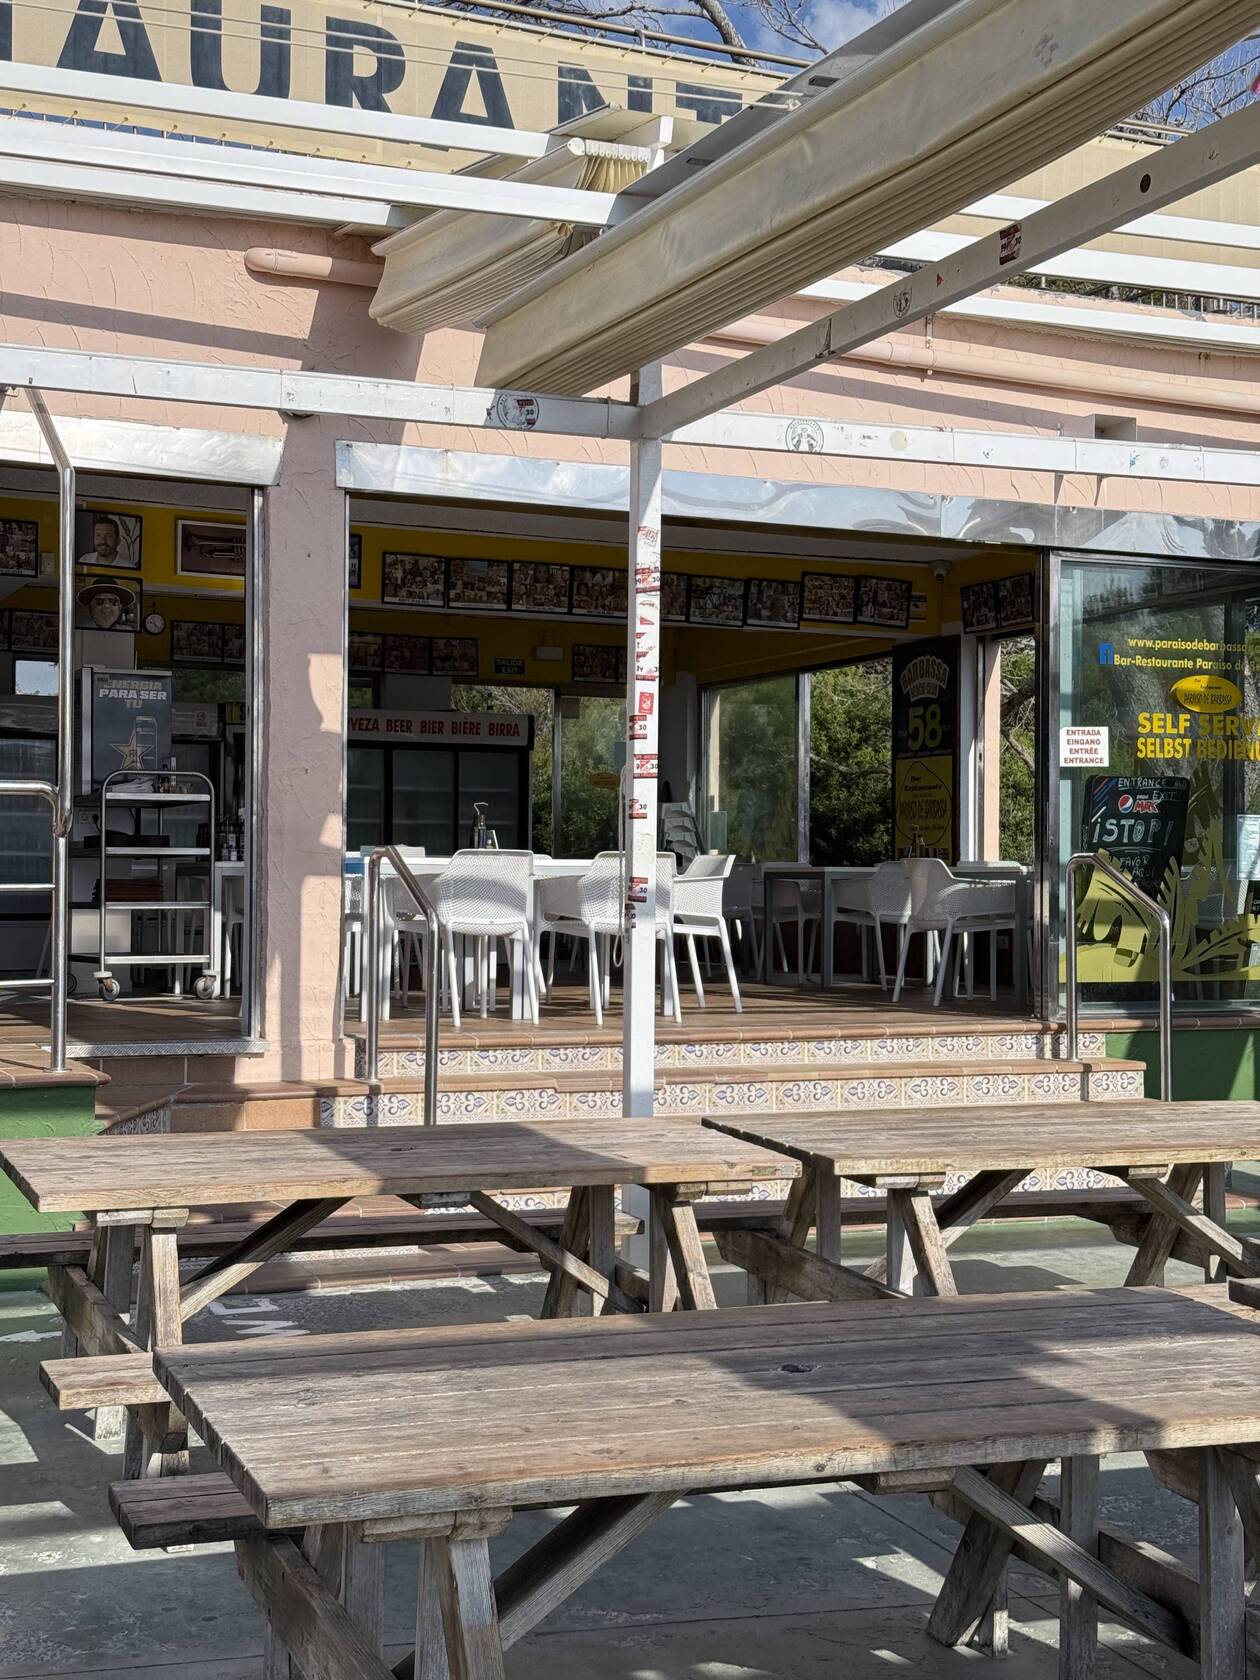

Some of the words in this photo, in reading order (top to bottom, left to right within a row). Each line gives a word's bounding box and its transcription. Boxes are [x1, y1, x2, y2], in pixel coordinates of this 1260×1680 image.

[1114, 655, 1194, 669] Bar-Restaurante
[1196, 657, 1232, 670] Paraiso
[99, 688, 137, 699] PARA
[139, 690, 168, 700] SER
[348, 717, 380, 733] VEZA
[386, 718, 413, 734] BEER
[420, 719, 445, 736] BIER
[451, 717, 481, 736] BIÈRE
[488, 722, 521, 737] BIRRA
[907, 703, 944, 752] 58
[1137, 711, 1191, 735] SELF
[1066, 729, 1101, 737] ENTRADA
[1066, 738, 1101, 746] EINGANG
[1136, 736, 1192, 759] SELBST
[1063, 757, 1104, 765] ENTRANCE
[1117, 777, 1168, 788] ENTRANCE
[1134, 799, 1158, 813] MAX
